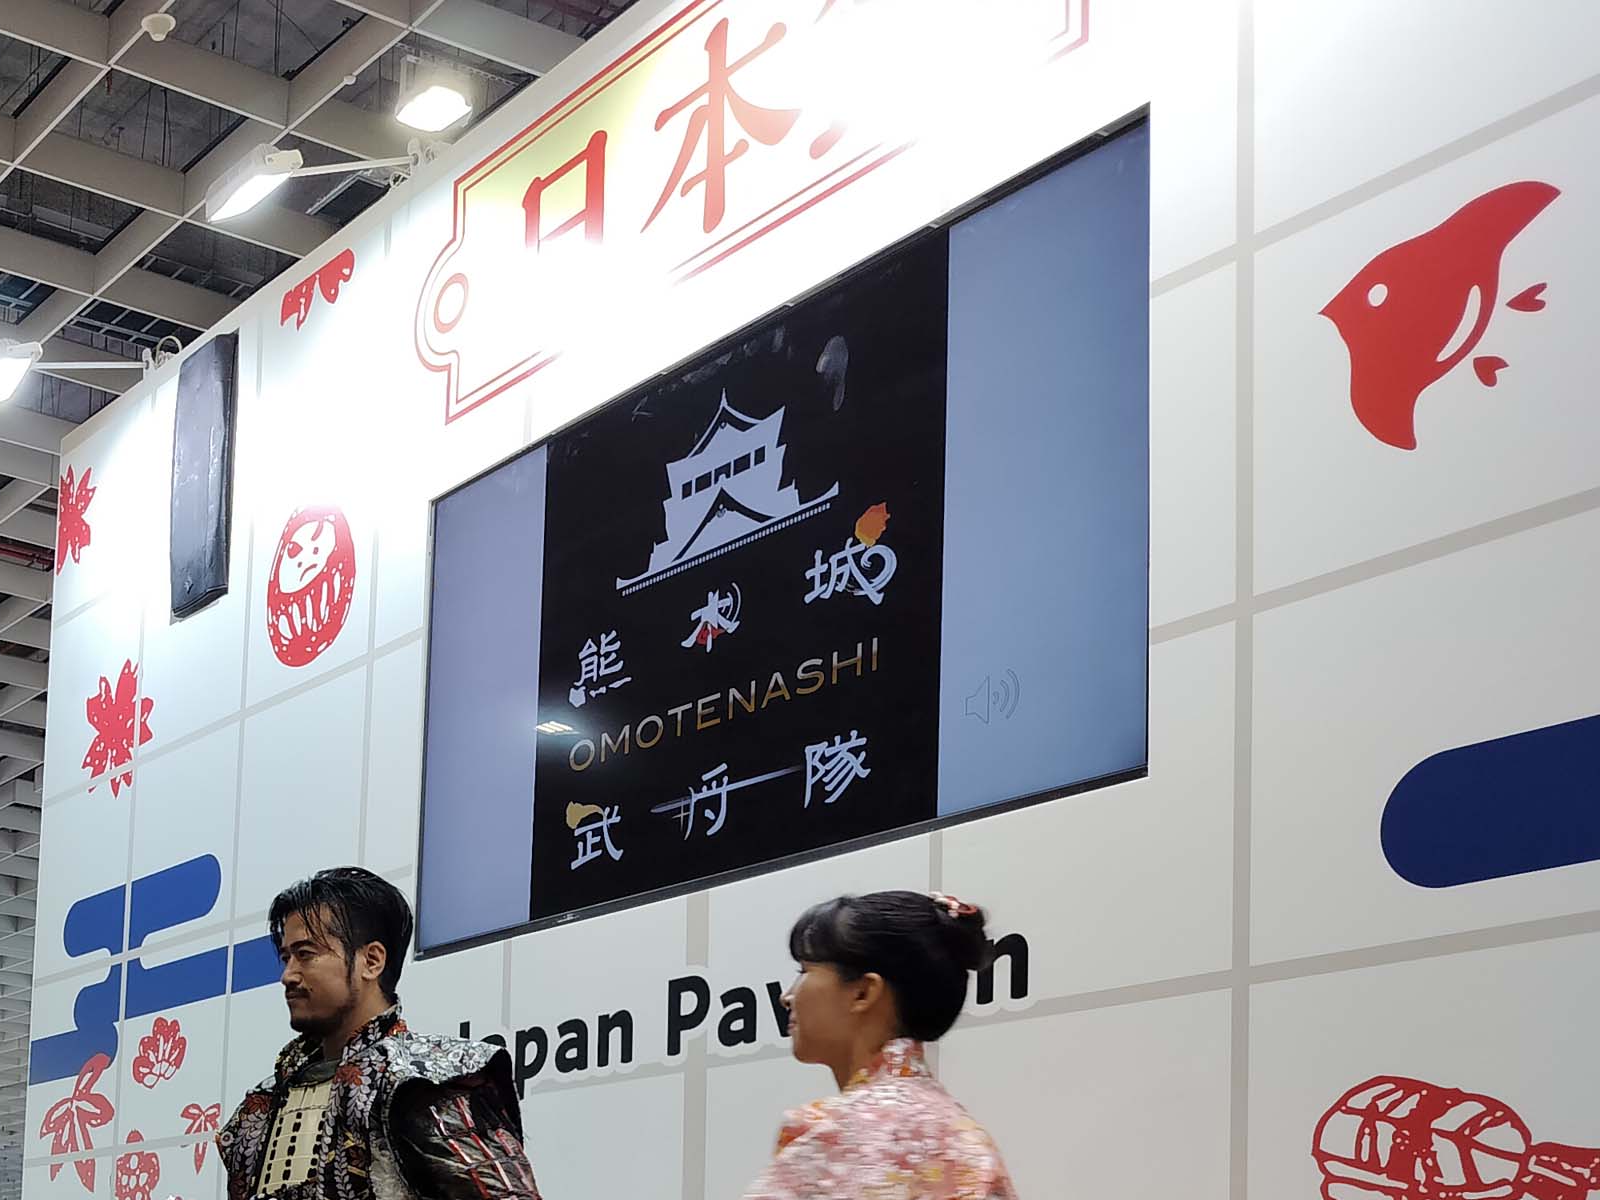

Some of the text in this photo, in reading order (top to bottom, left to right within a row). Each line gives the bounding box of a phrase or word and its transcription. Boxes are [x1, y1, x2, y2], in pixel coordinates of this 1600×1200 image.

[568, 638, 879, 771] OMOTENASHI
[459, 930, 1029, 1101] pan Pavn
